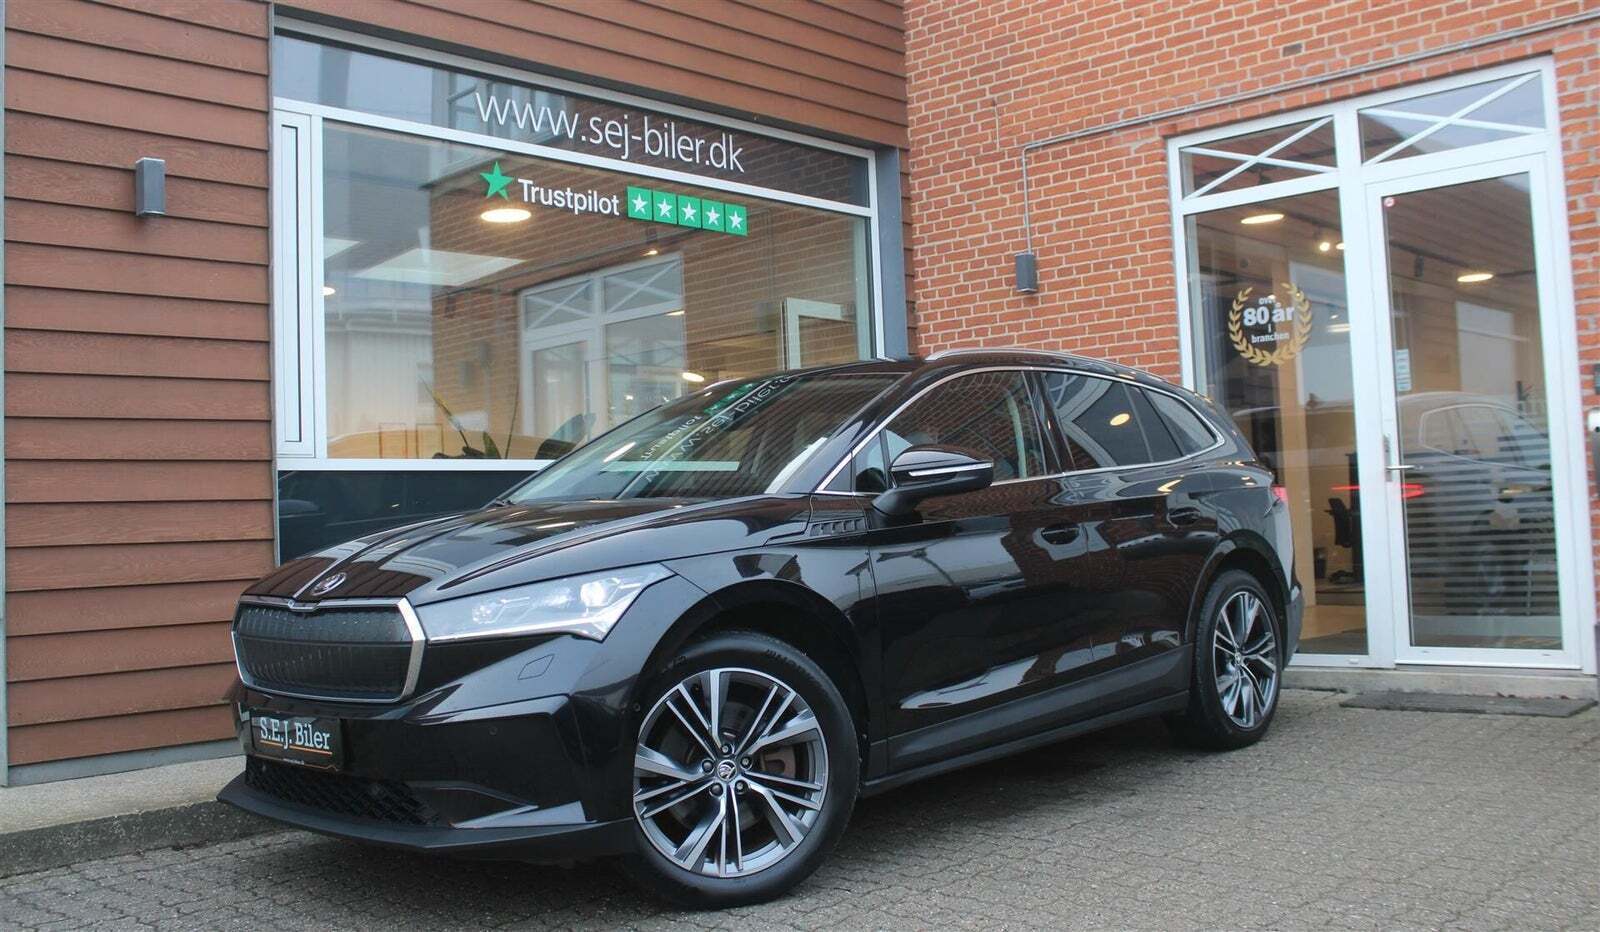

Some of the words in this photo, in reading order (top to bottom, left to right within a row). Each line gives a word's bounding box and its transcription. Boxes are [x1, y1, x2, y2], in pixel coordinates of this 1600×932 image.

[475, 92, 745, 173] www.sej-biler.dk
[517, 178, 620, 216] Trustpilot
[1243, 306, 1270, 326] 80
[1271, 302, 1295, 323] år
[1251, 332, 1290, 344] branchen
[260, 717, 293, 750] S.E.J.
[295, 722, 331, 750] Biler
